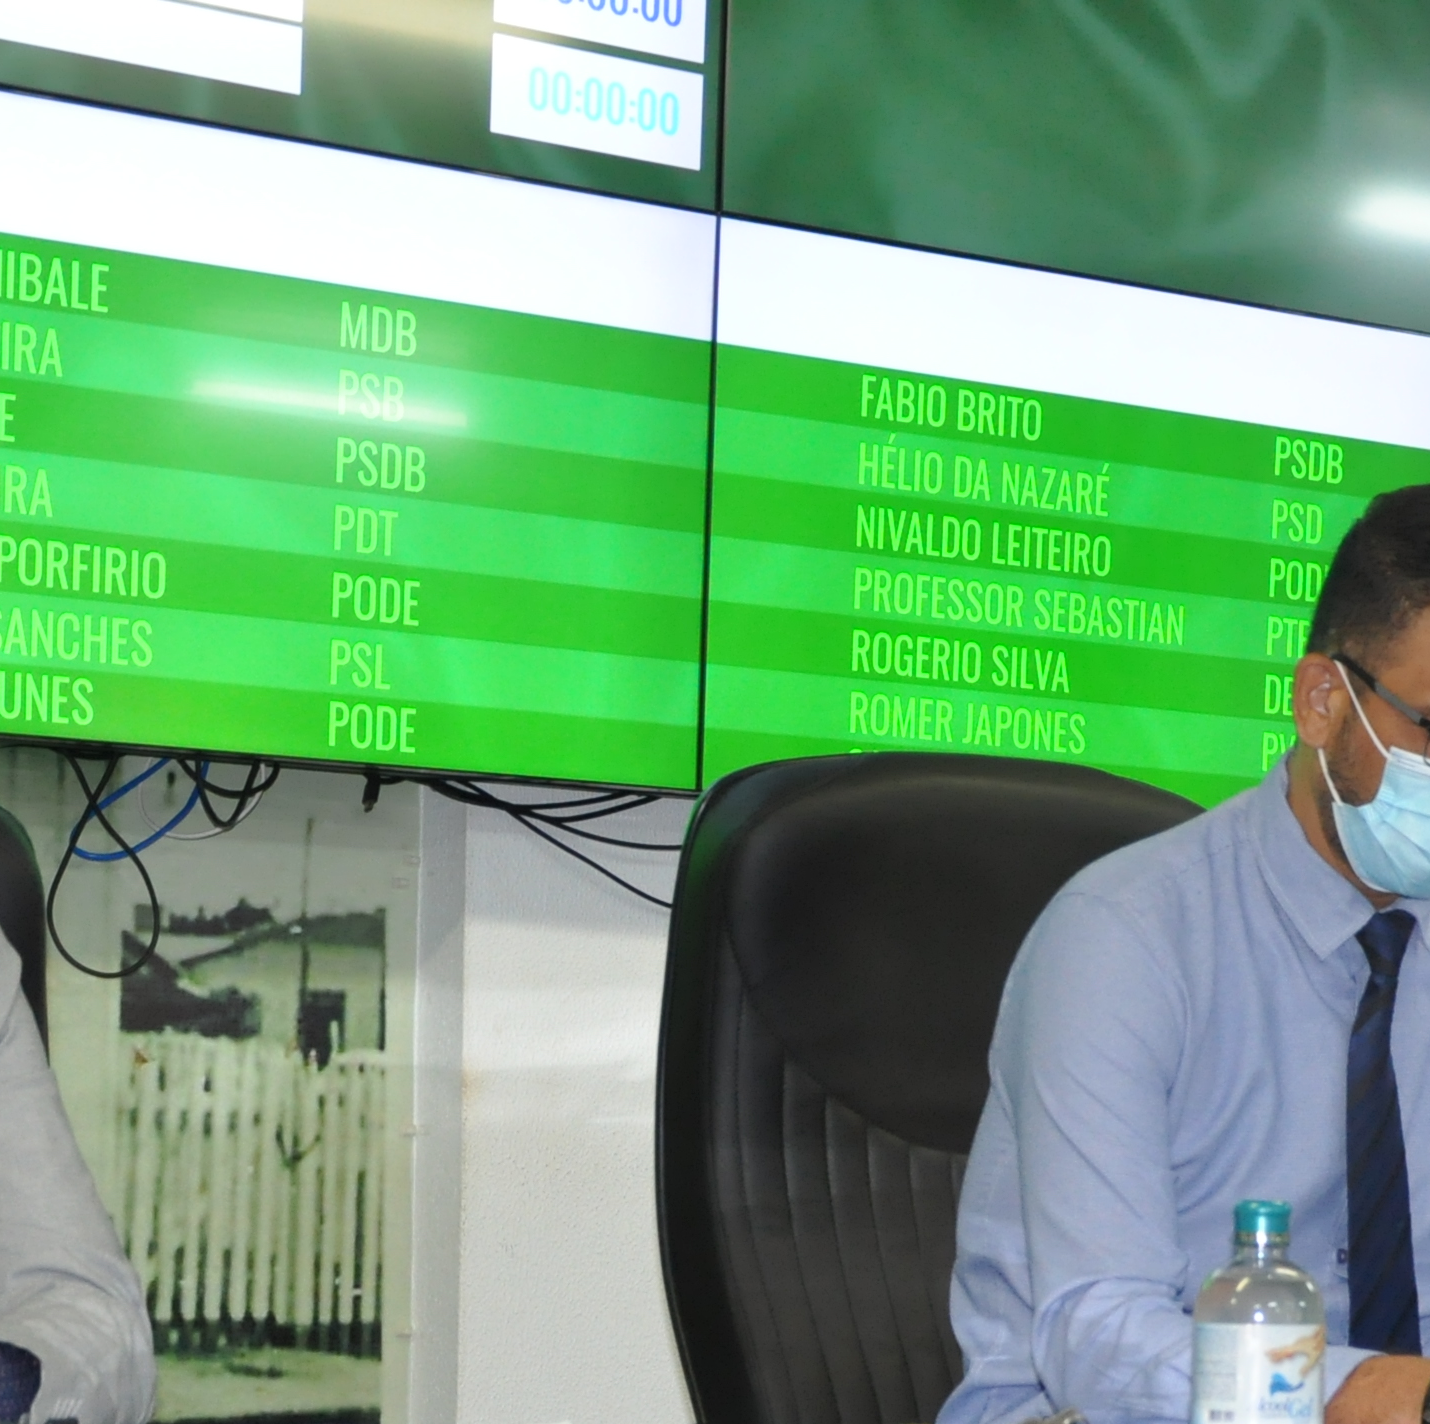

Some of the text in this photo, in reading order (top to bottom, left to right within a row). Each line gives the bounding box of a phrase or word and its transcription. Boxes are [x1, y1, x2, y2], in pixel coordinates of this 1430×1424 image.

[529, 66, 679, 136] 00:00:00
[340, 301, 417, 357] MDB
[337, 368, 405, 423] PSB
[860, 374, 1043, 441] FABIO BRITO
[335, 436, 426, 493] PSDB
[858, 432, 1110, 518] HÉLIO DA NAZARÉ
[1274, 436, 1344, 485] PSDB
[333, 503, 399, 557] PDT
[856, 504, 1112, 577] NIVALDO LEITEIRO
[1272, 499, 1323, 545] PSD
[331, 571, 420, 627] PODE
[854, 566, 1185, 646] PROFESSOR SEBASTIAN
[1269, 557, 1329, 602] POD
[330, 638, 391, 690] PSL
[851, 628, 1070, 694] ROGERIO SILVA
[328, 700, 417, 754] PODE
[849, 691, 1086, 755] ROMER JAPONES
